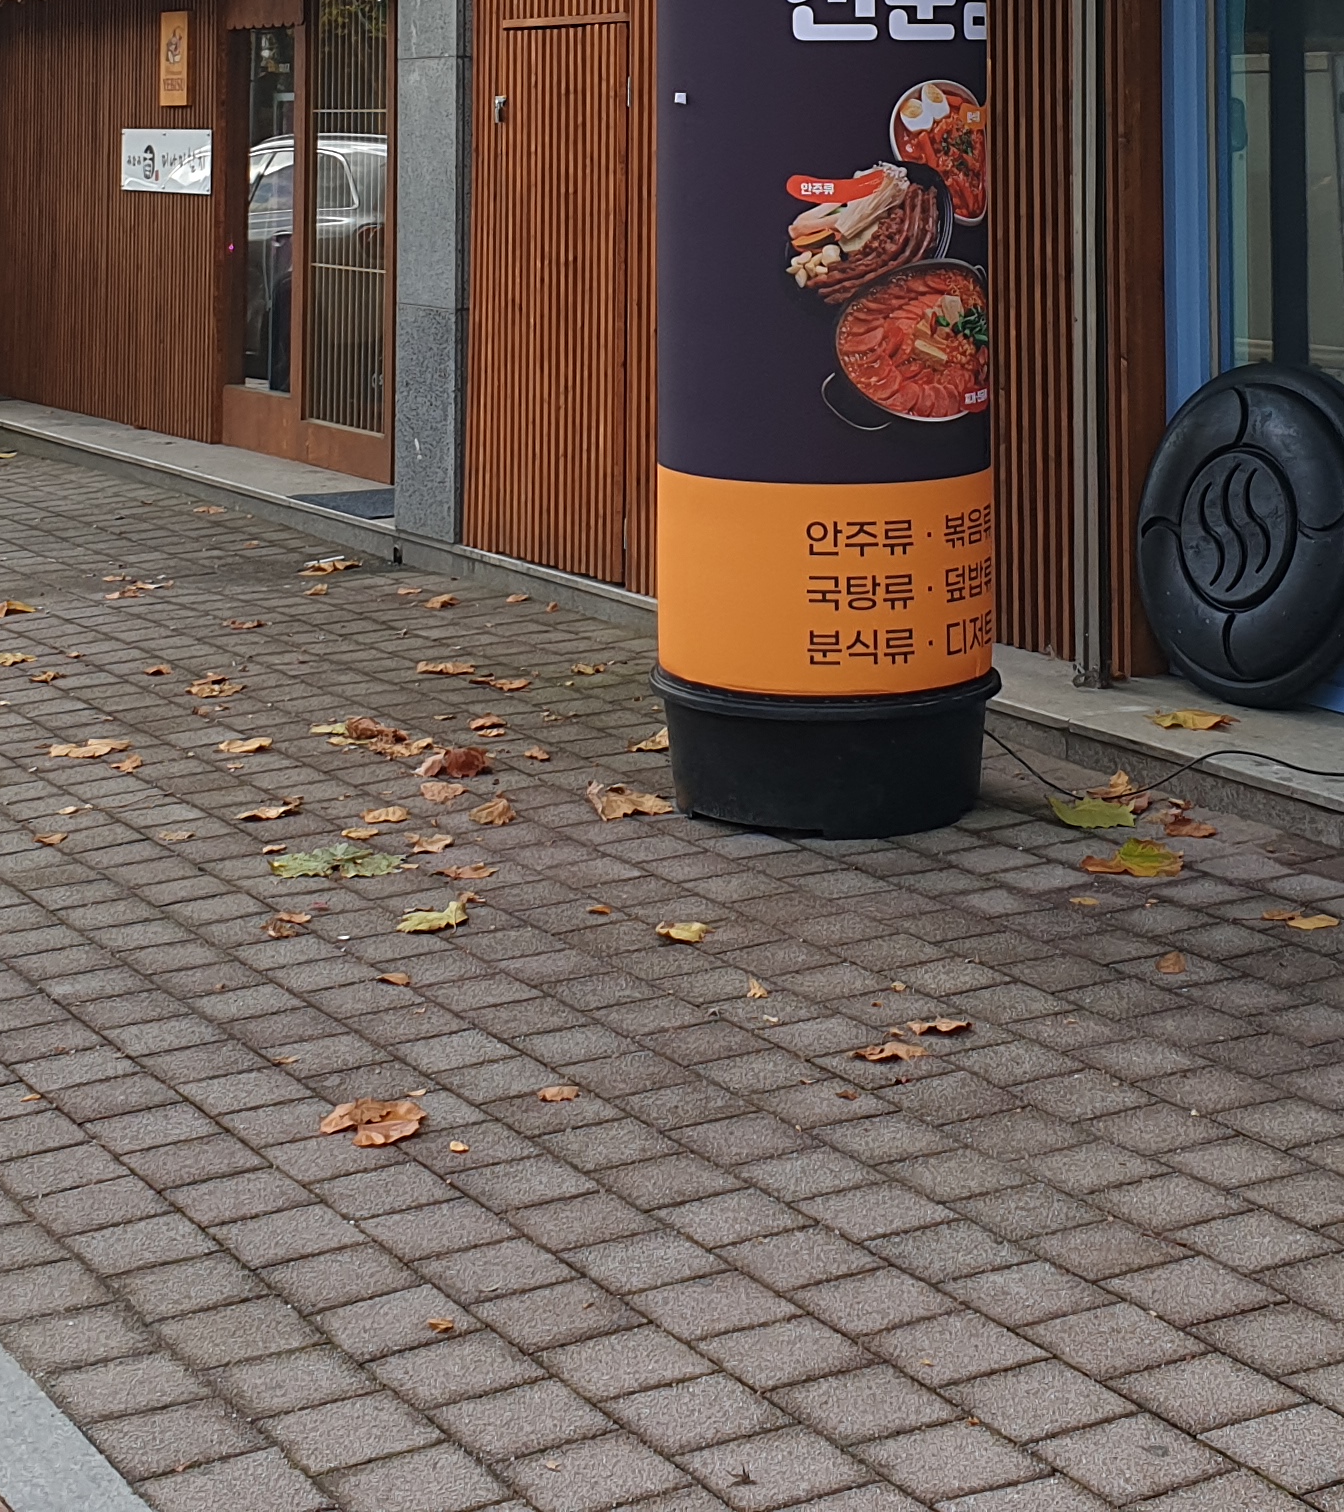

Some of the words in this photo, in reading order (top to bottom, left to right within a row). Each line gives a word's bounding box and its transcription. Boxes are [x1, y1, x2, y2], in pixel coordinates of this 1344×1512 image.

[800, 181, 835, 195] 안주류
[806, 519, 914, 558] 안주류
[806, 573, 915, 611] 국탕류
[806, 627, 915, 666] 분식류
